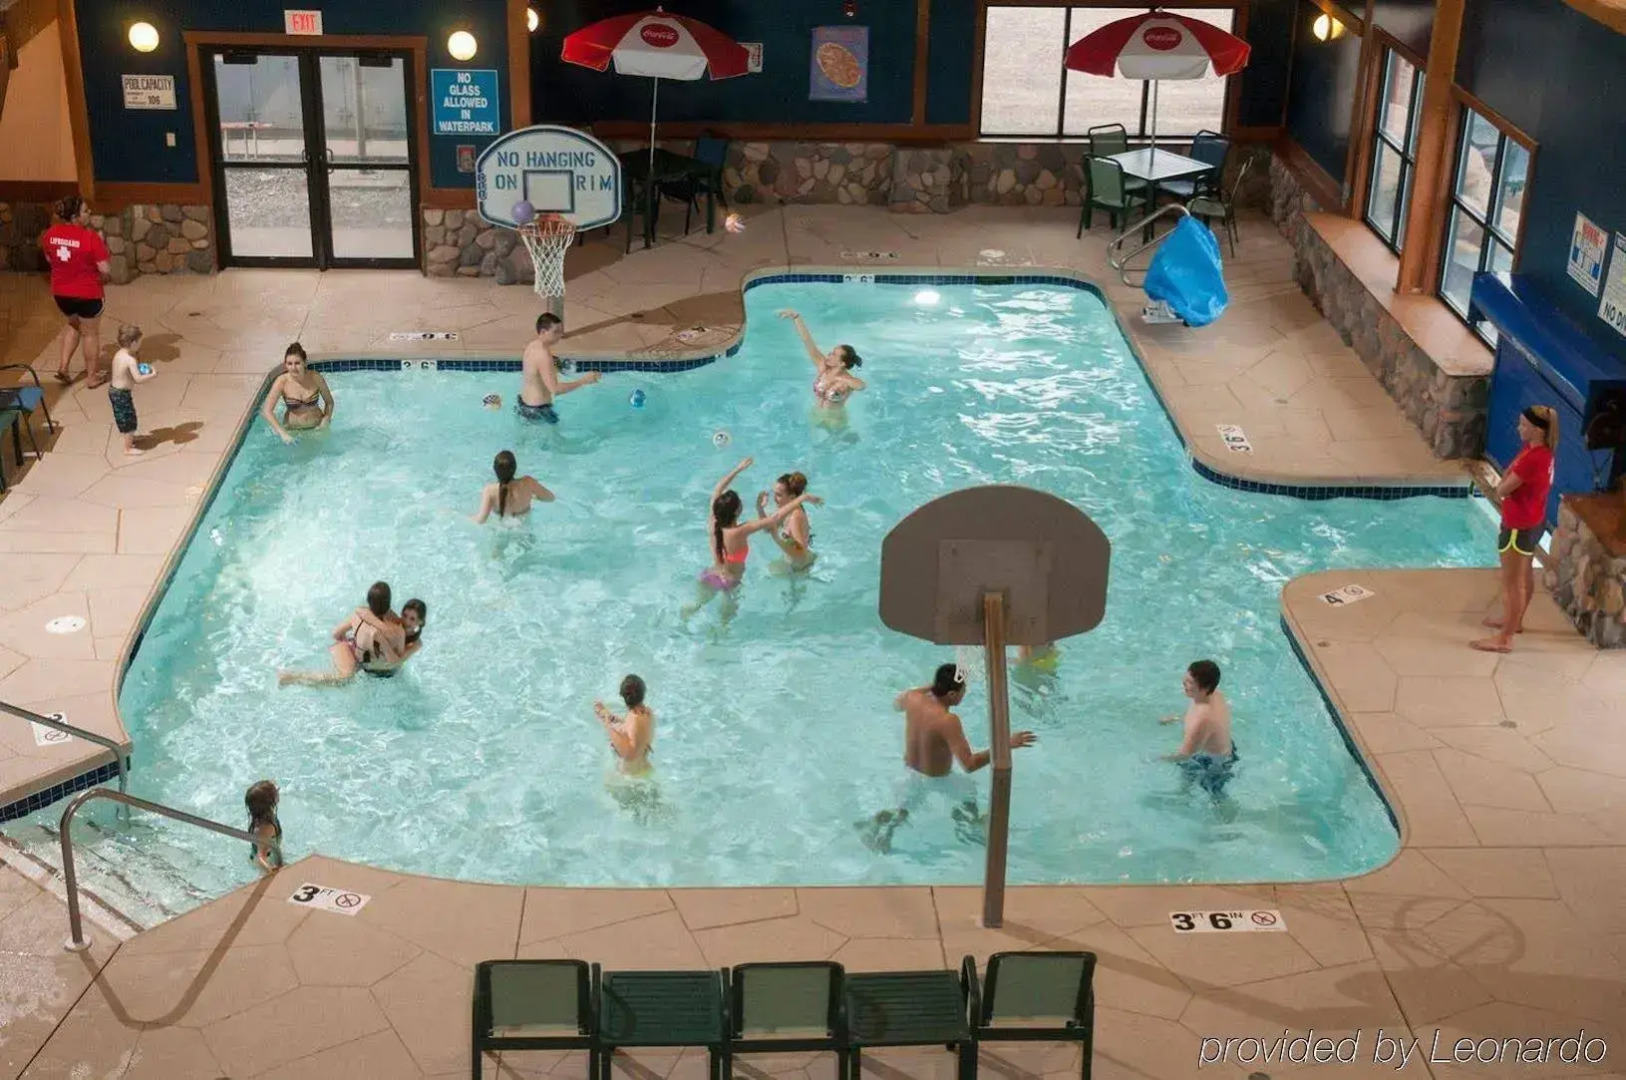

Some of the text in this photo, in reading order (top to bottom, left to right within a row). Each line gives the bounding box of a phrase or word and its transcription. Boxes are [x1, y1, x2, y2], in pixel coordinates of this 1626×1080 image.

[291, 13, 315, 32] EXIT
[125, 78, 171, 91] POOL CAPACITY
[457, 72, 471, 84] NO
[449, 84, 480, 97] GLASS
[148, 95, 160, 105] 106
[443, 97, 488, 108] ALLOWED
[461, 109, 471, 120] IN
[439, 120, 494, 132] WATERPARK
[497, 151, 595, 168] NO HANGING
[495, 174, 518, 190] ON
[576, 174, 614, 191] RIM
[1604, 301, 1616, 321] NO
